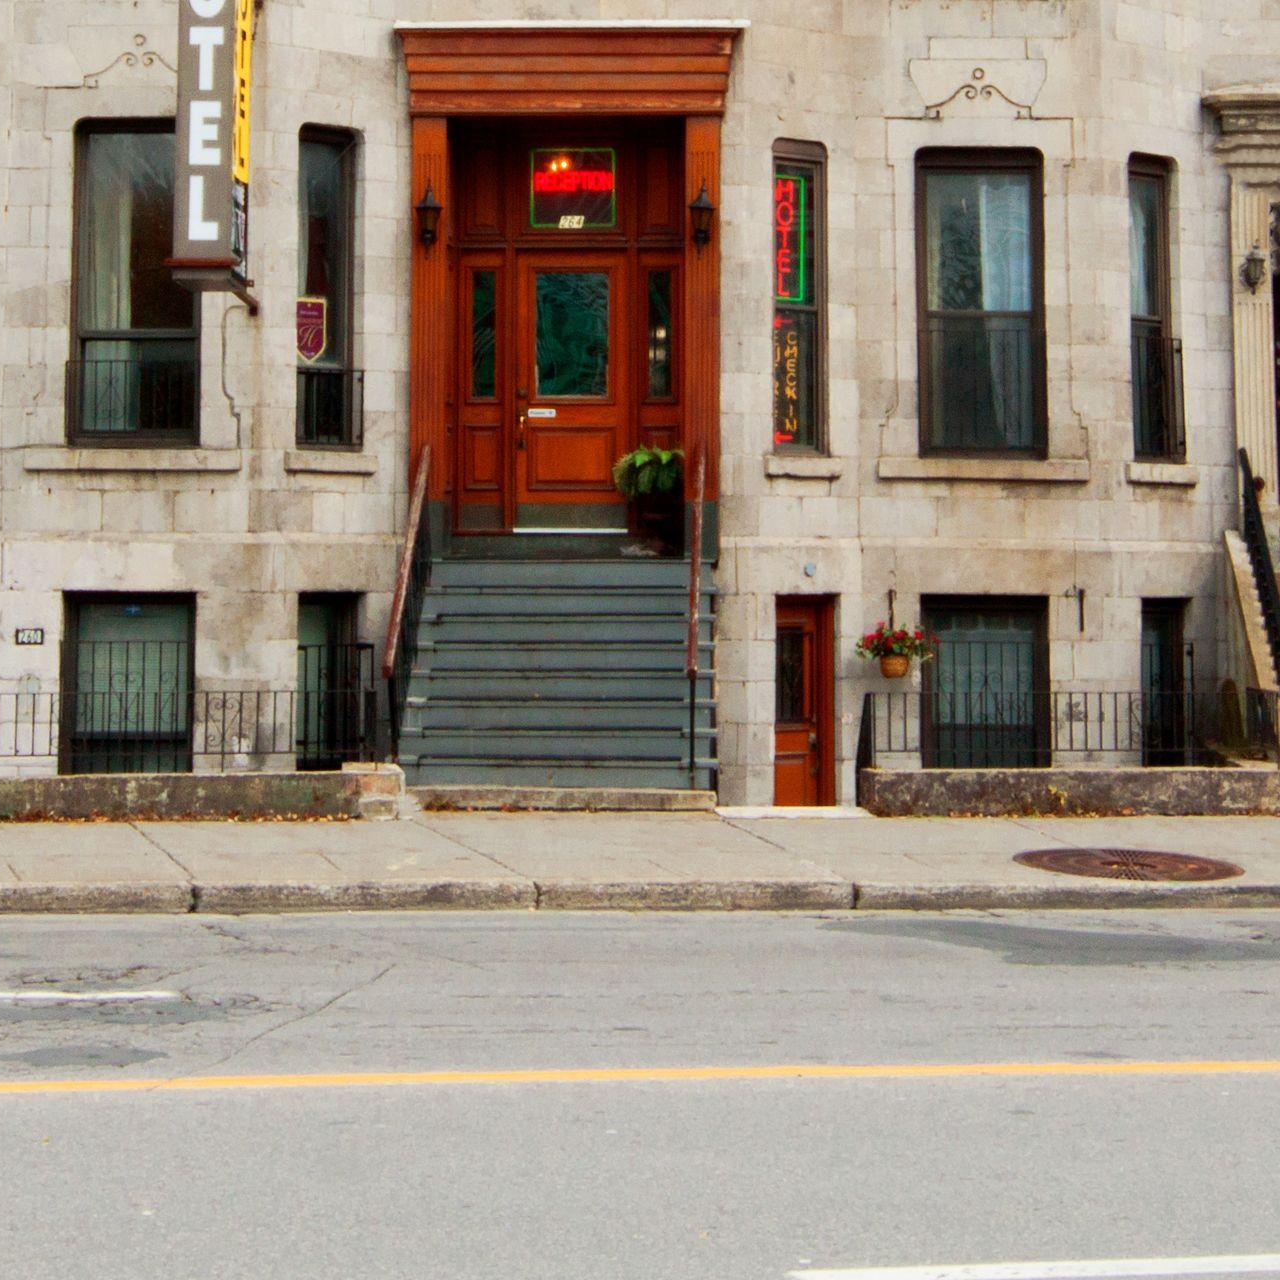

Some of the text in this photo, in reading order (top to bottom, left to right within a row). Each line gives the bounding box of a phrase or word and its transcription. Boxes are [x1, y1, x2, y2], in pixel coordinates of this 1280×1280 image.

[775, 179, 794, 298] HOTEL
[784, 331, 799, 432] CHECK IN
